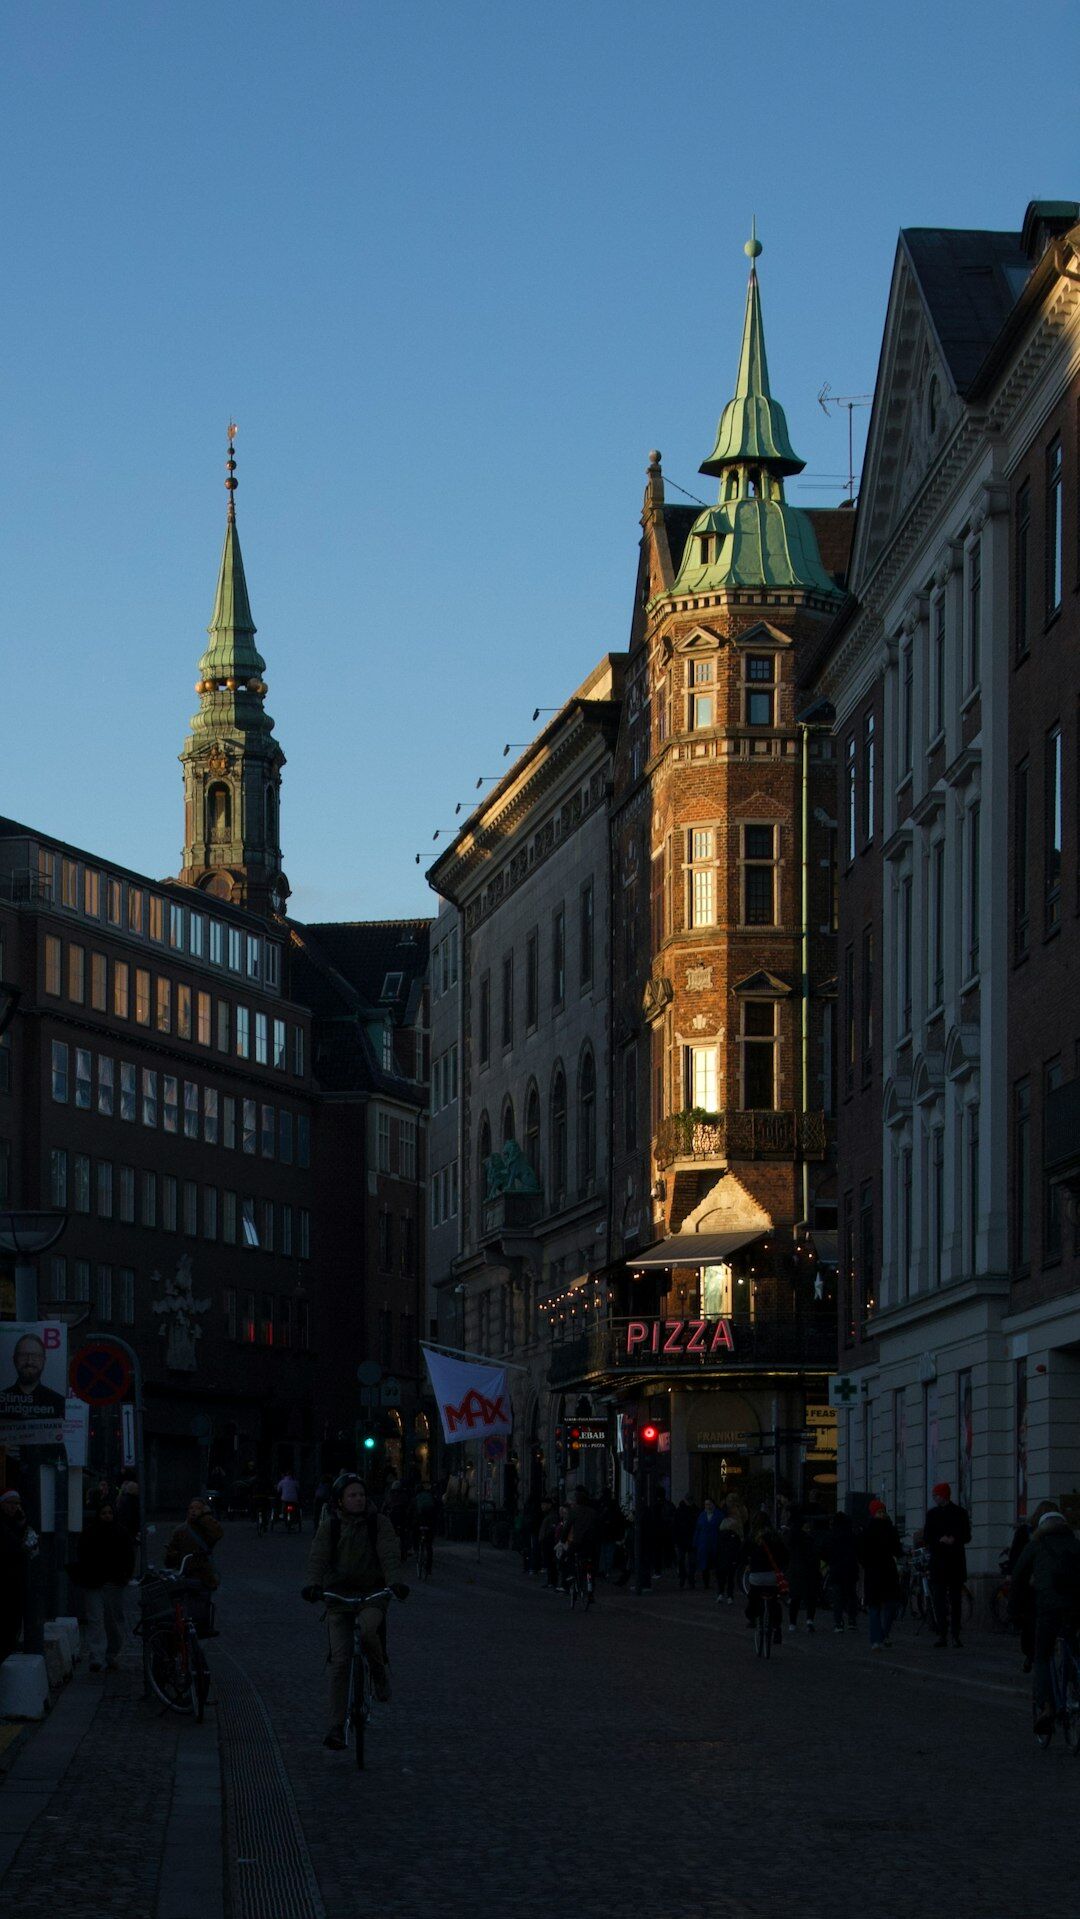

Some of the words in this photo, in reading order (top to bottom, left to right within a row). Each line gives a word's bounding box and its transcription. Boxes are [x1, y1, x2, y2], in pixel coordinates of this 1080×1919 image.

[44, 1328, 61, 1349] B
[626, 1318, 735, 1354] PIZZA
[0, 1391, 33, 1403] Stinus
[0, 1403, 54, 1416] Lindgreen
[445, 1389, 509, 1431] MAX
